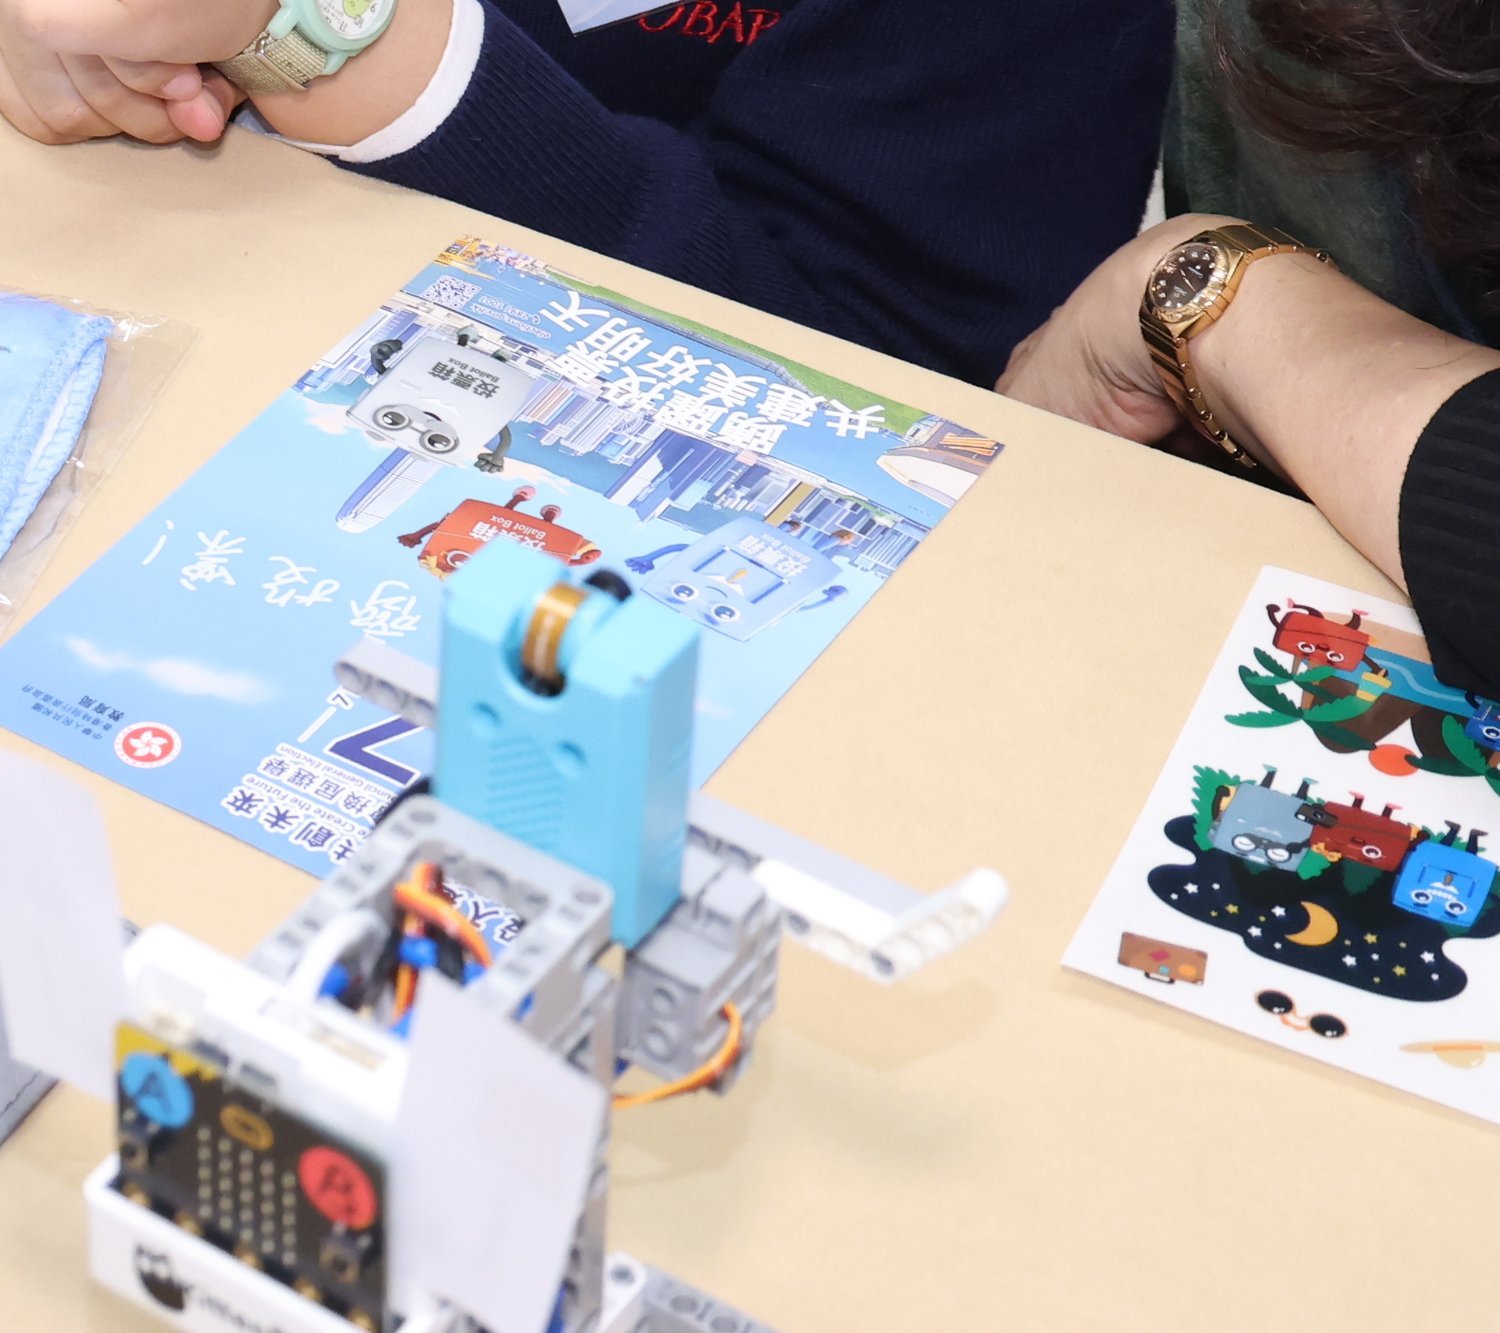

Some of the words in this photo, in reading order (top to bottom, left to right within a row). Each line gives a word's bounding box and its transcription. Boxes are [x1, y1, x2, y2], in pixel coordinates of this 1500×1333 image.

[448, 357, 469, 371] Box
[470, 366, 500, 383] Ballot
[537, 289, 888, 440] 共建美好明天
[428, 361, 500, 399] 投票箱
[545, 343, 789, 456] 踴躍投票
[489, 514, 514, 528] Box
[513, 522, 547, 540] Ballot
[760, 533, 782, 547] Box
[736, 534, 809, 577] 投票箱
[780, 542, 812, 564] Ballot
[78, 695, 125, 723] 教育局
[280, 745, 322, 769] Election
[322, 763, 364, 788] General
[246, 776, 289, 800] Future
[290, 796, 311, 811] the
[314, 807, 356, 832] Create
